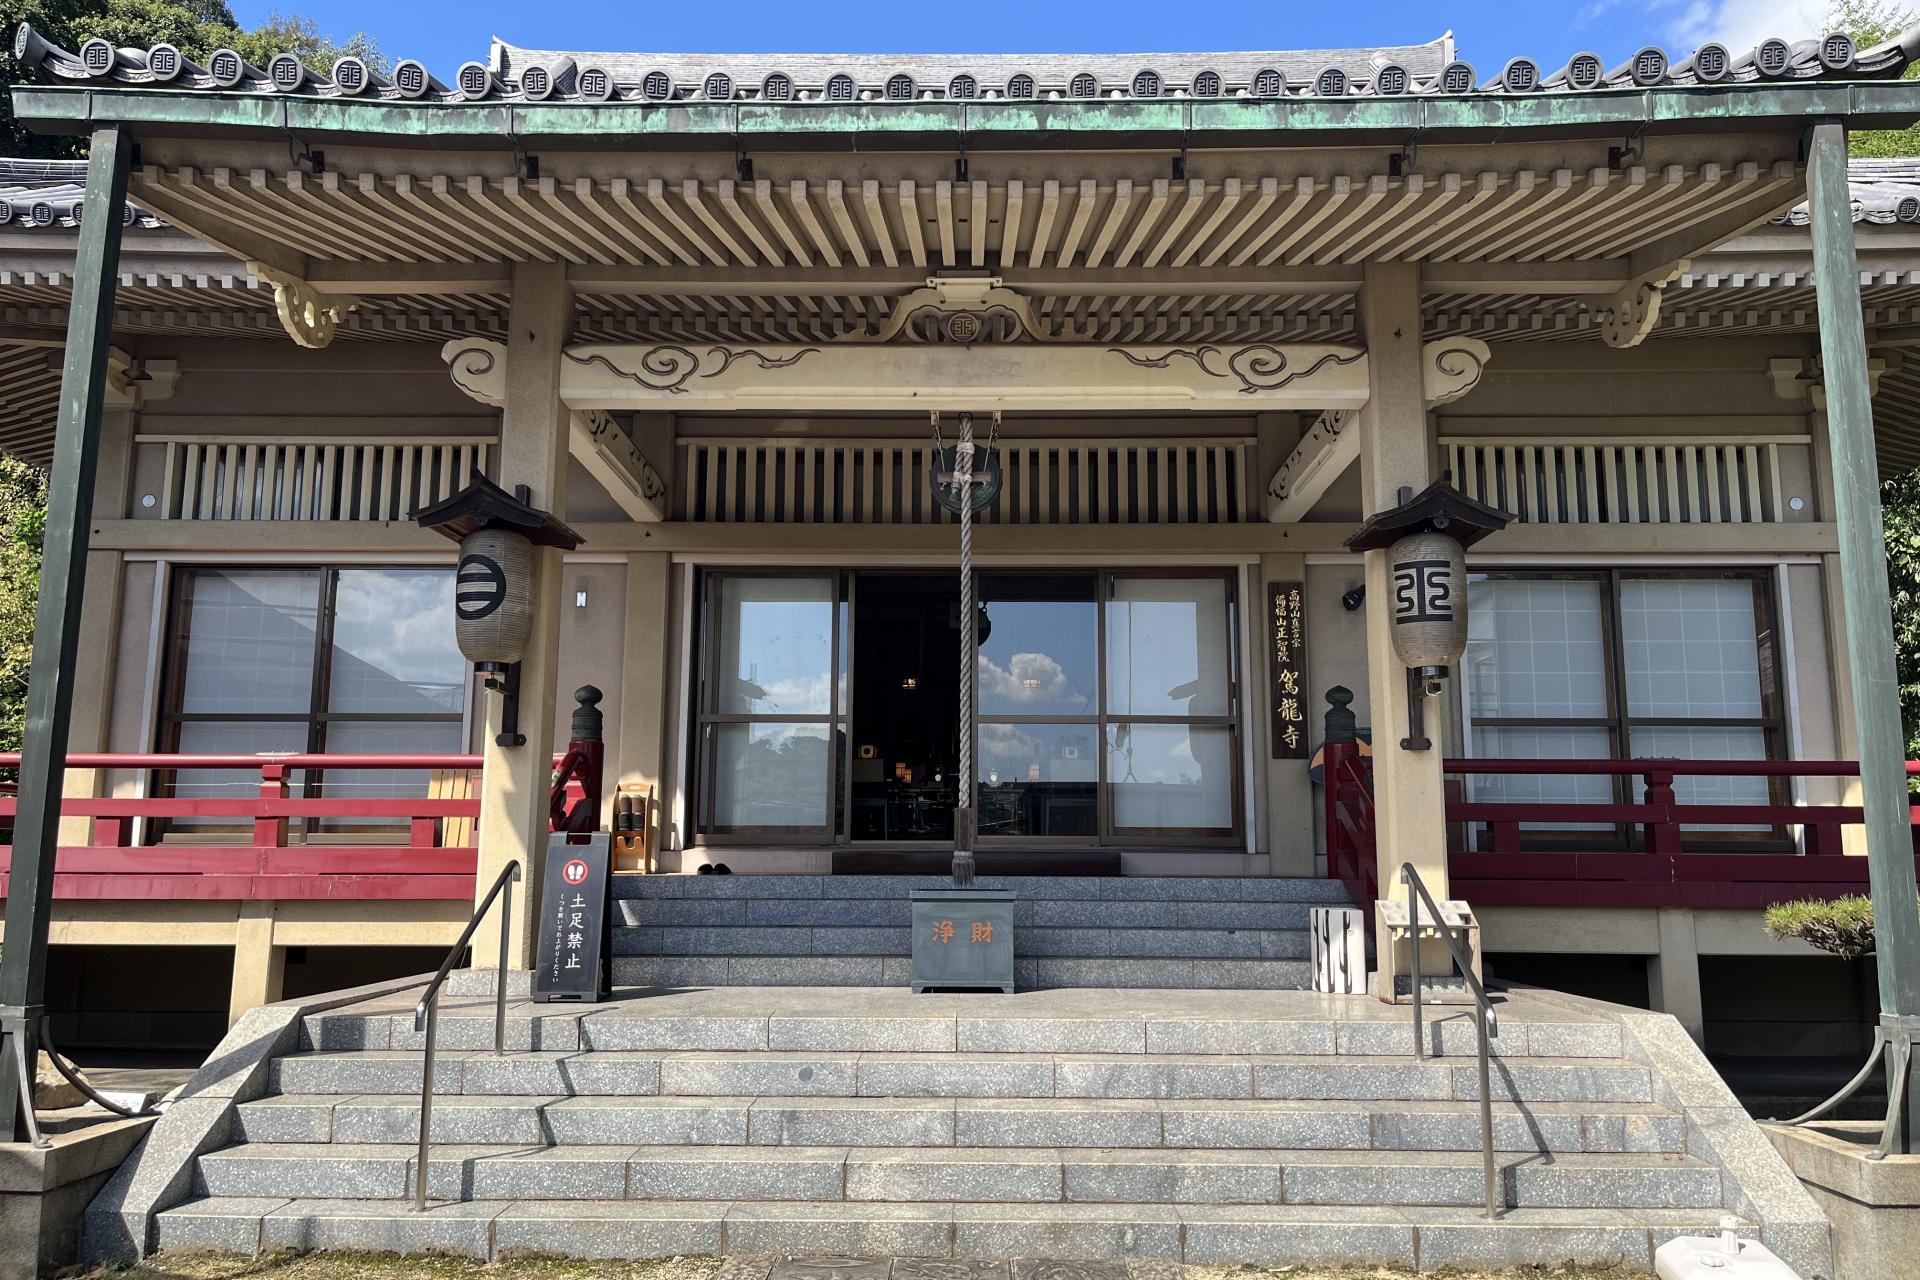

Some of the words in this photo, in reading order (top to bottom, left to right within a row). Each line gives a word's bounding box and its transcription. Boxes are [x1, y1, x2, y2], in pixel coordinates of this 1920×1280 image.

[1289, 589, 1301, 648] 高野山真言宗
[1278, 668, 1303, 749] 駕龍寺
[552, 893, 565, 983] くつを脱いでお上がりください
[565, 893, 586, 969] 土足禁止
